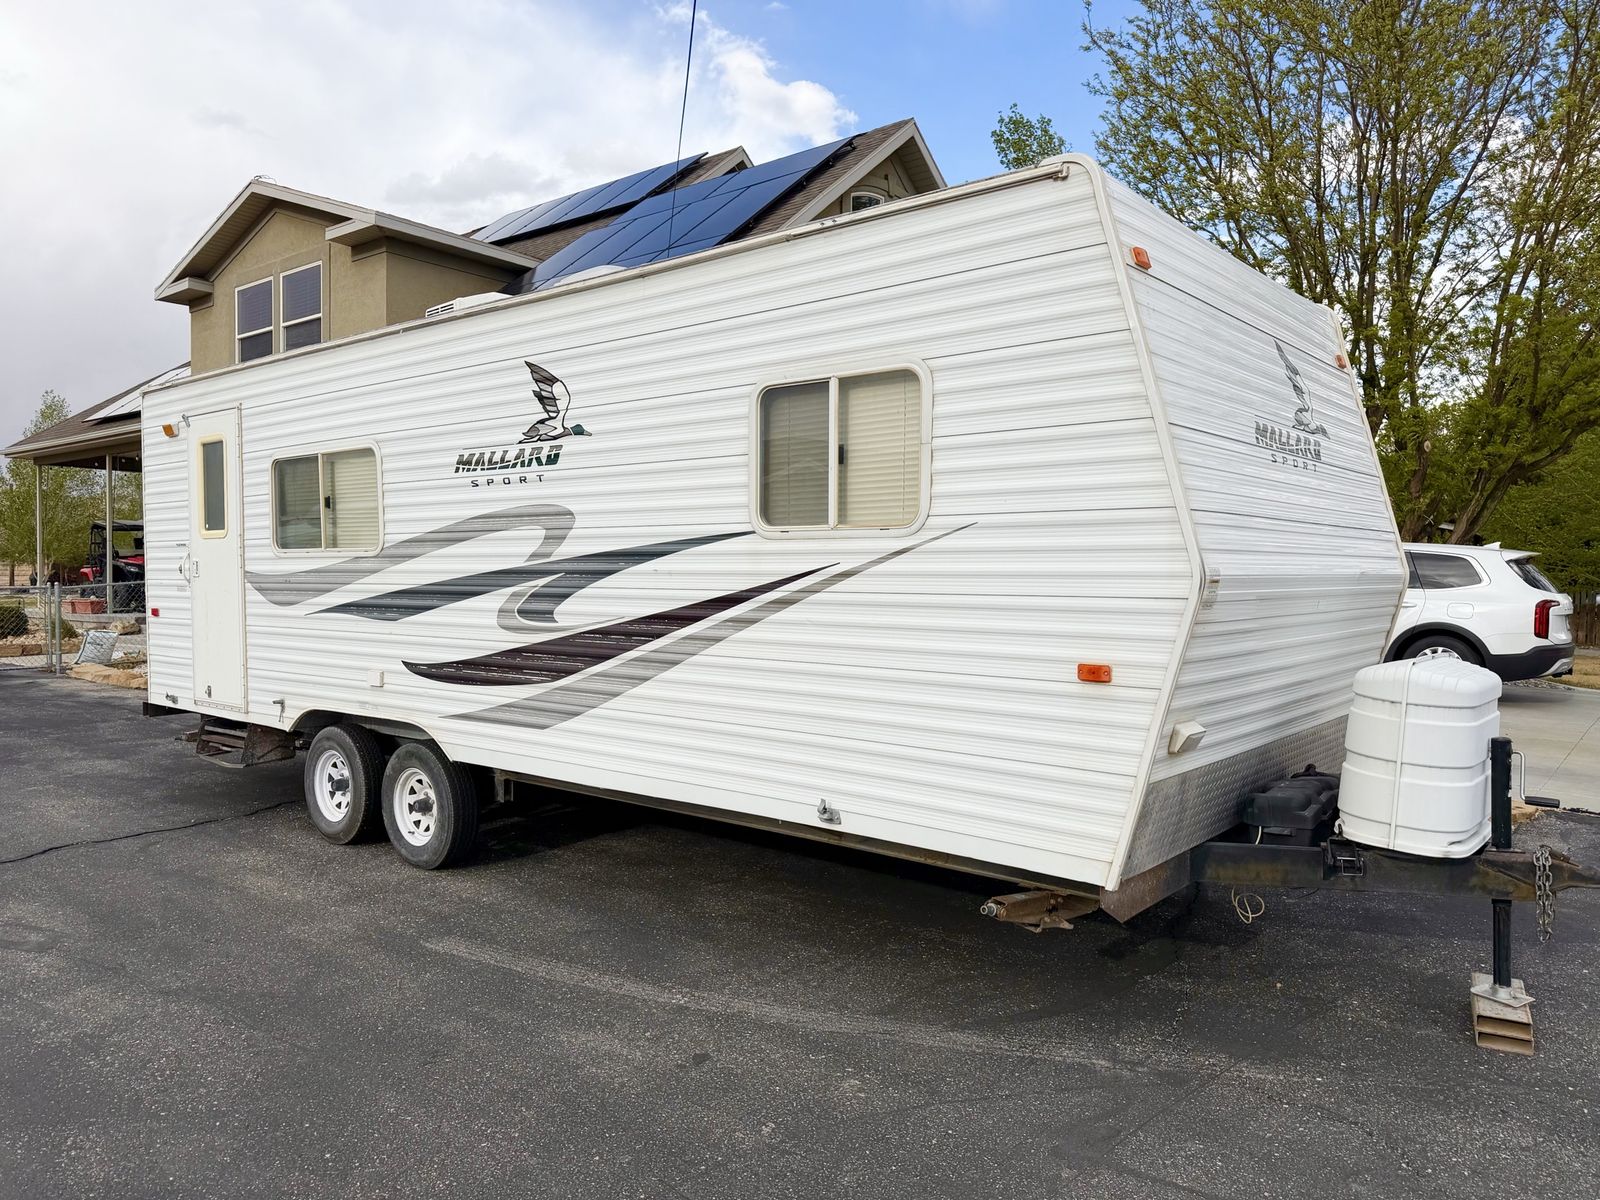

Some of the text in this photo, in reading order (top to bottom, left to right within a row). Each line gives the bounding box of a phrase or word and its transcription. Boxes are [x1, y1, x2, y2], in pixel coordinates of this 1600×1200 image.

[1254, 421, 1322, 461] MALLARD
[454, 444, 563, 474] MALLARD
[1270, 453, 1318, 472] SPORT
[470, 474, 545, 488] SPORT
